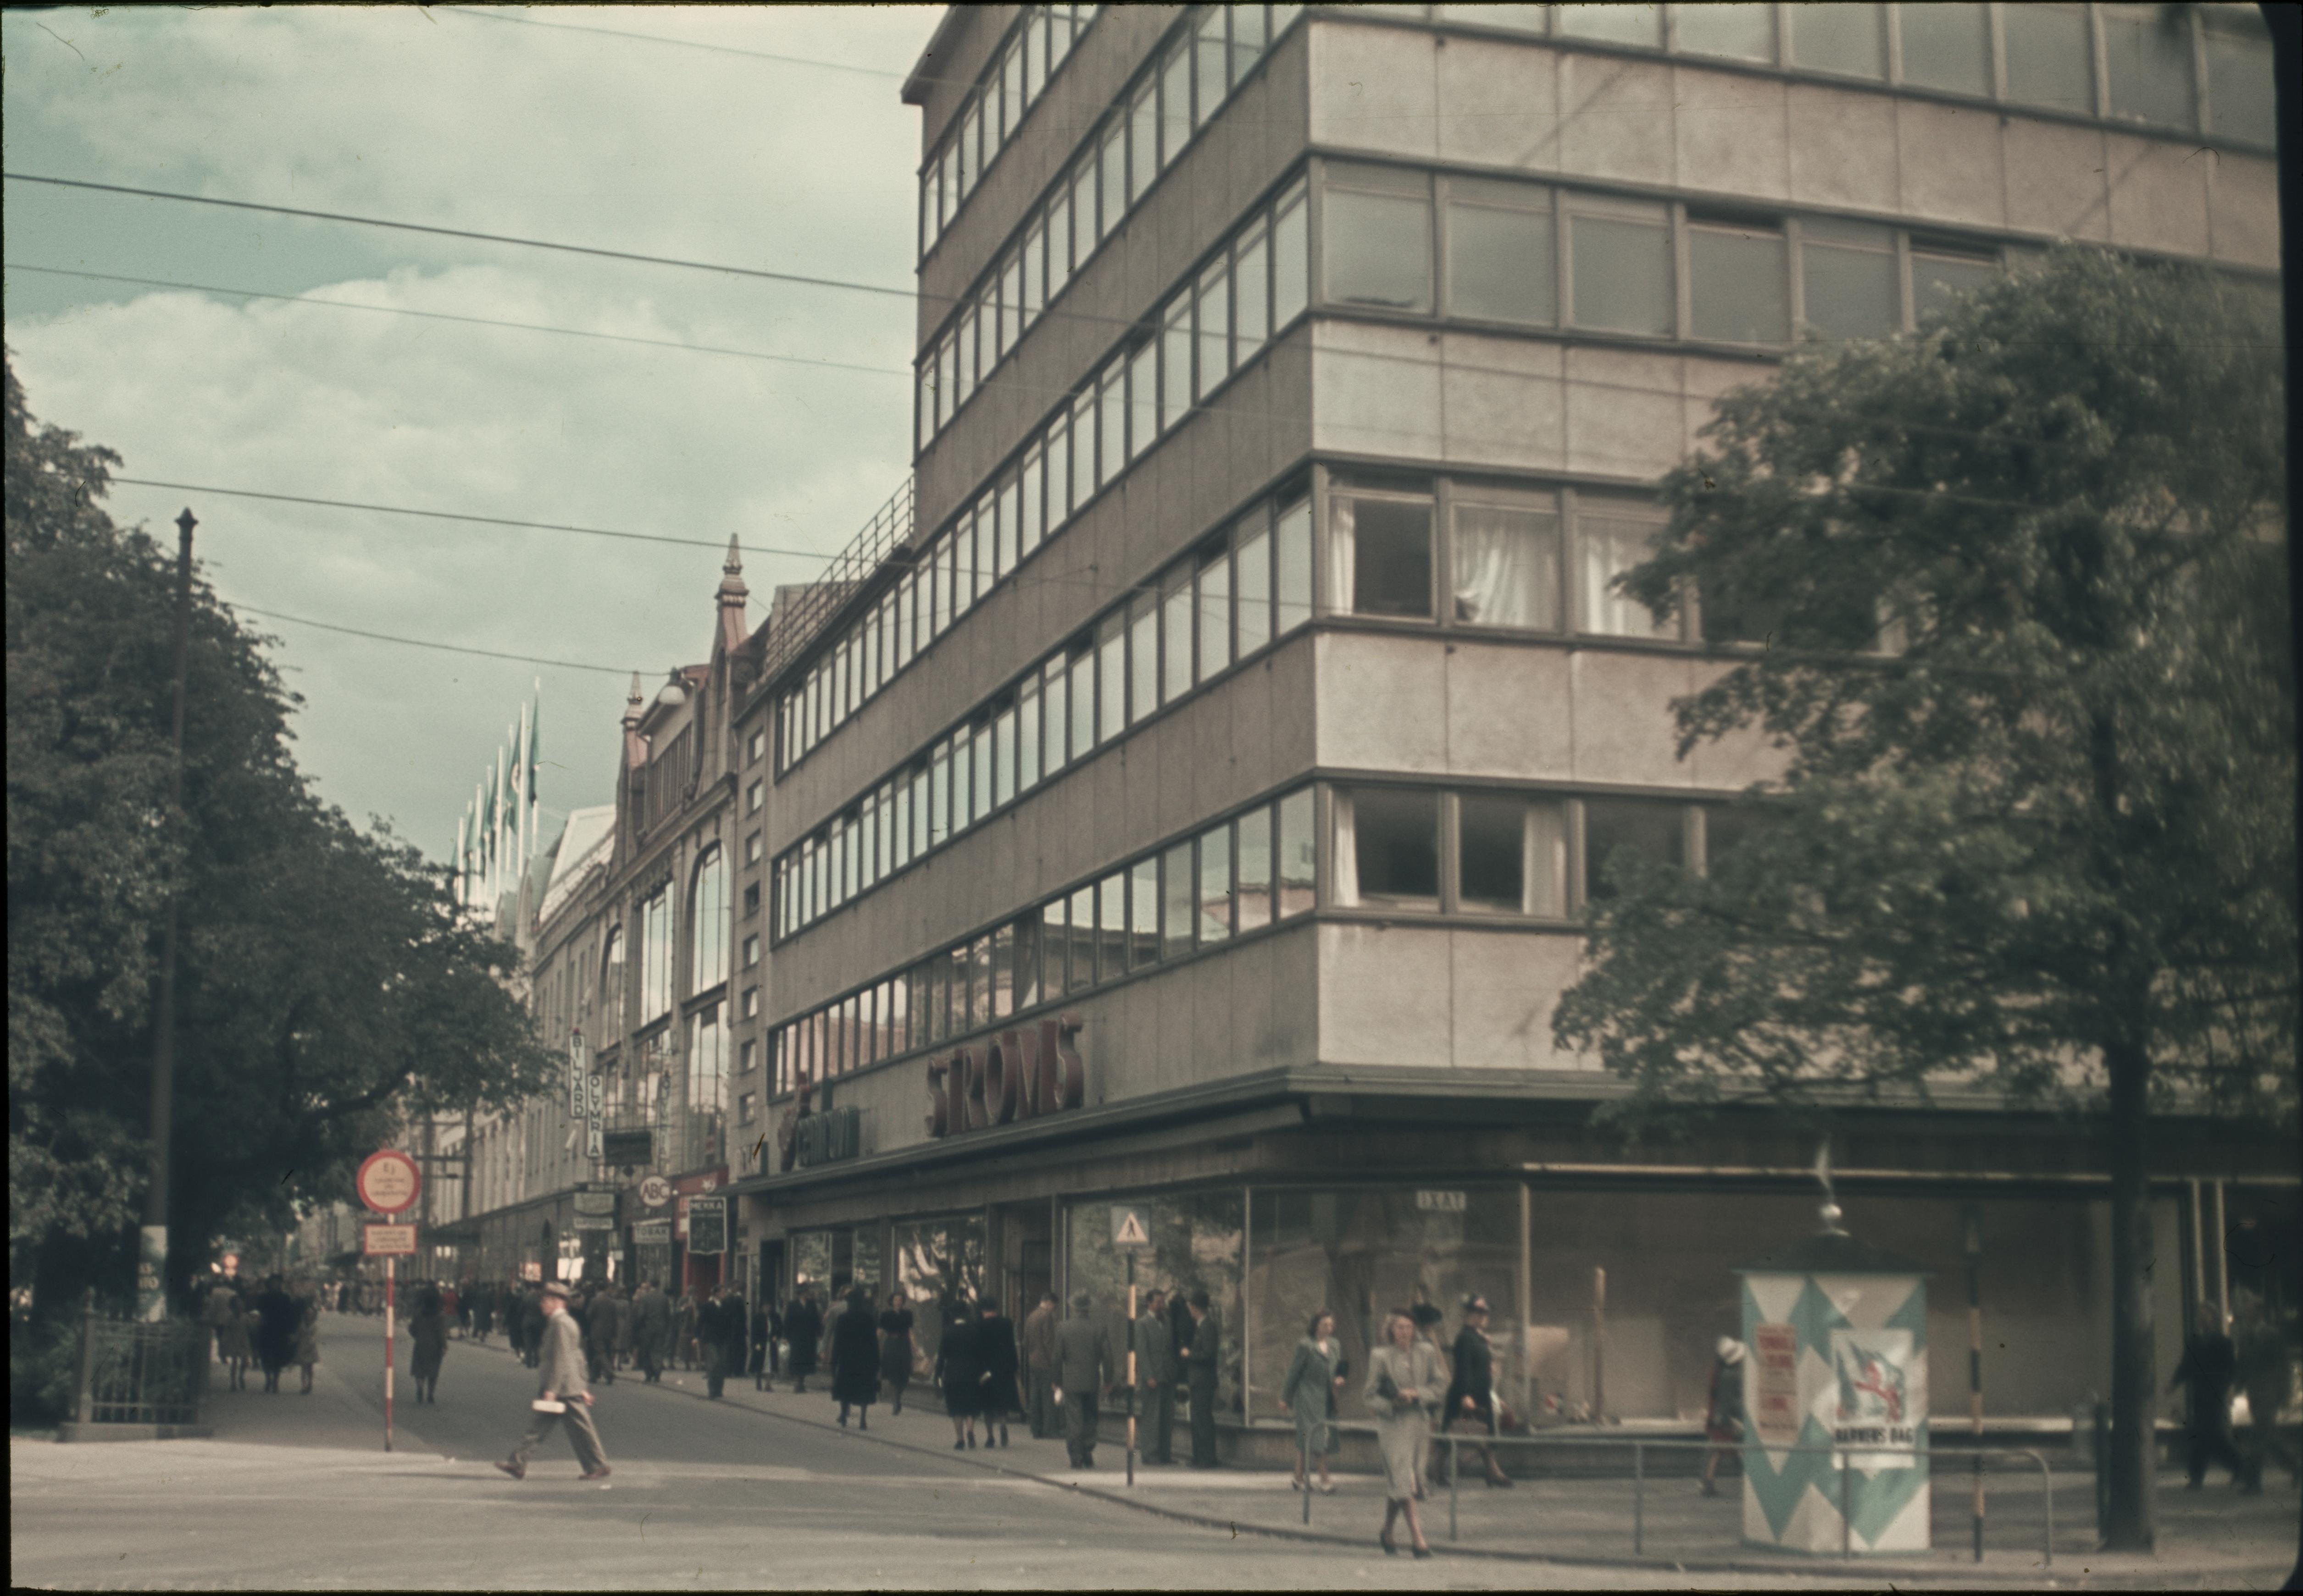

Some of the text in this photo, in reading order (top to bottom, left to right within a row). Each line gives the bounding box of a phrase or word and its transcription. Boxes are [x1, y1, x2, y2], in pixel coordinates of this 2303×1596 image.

[572, 1037, 584, 1115] BILJARD
[383, 1162, 395, 1175] Ej
[643, 1182, 668, 1199] ABC
